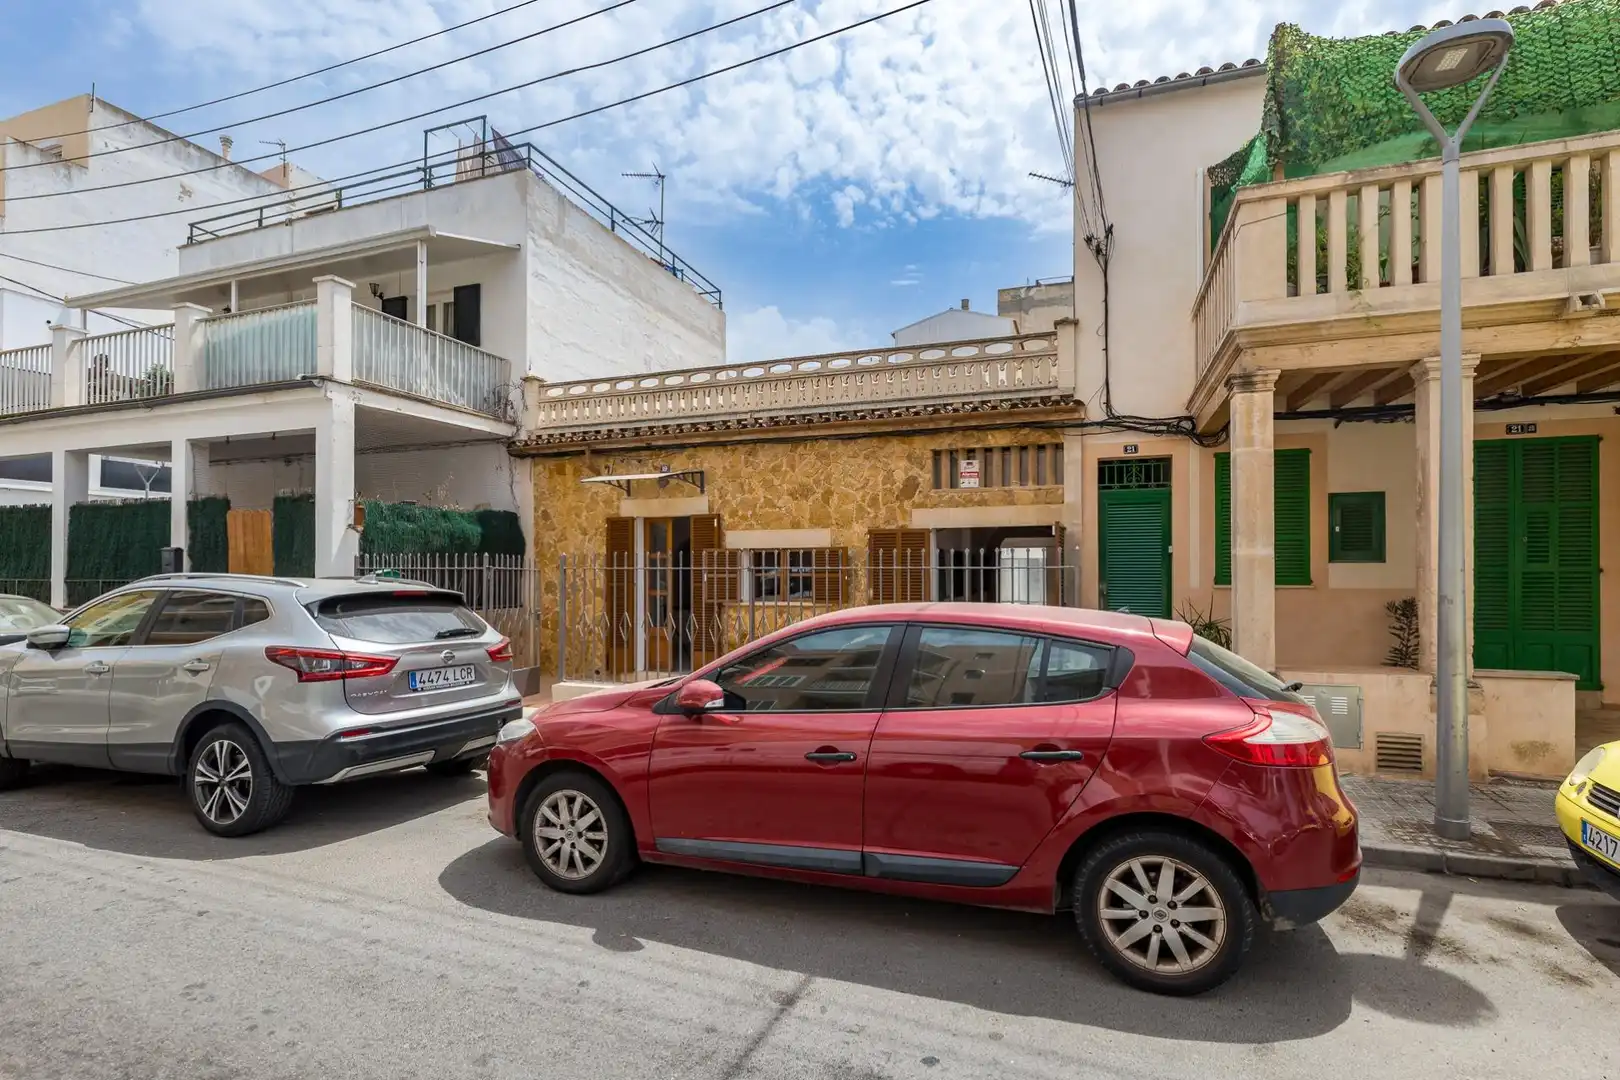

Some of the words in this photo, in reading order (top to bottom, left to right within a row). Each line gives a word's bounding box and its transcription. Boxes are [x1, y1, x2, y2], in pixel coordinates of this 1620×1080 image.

[1511, 424, 1521, 433] 21
[1126, 445, 1135, 453] 21
[419, 669, 450, 685] 4474
[453, 667, 473, 682] LCR
[1589, 827, 1618, 858] 4217
